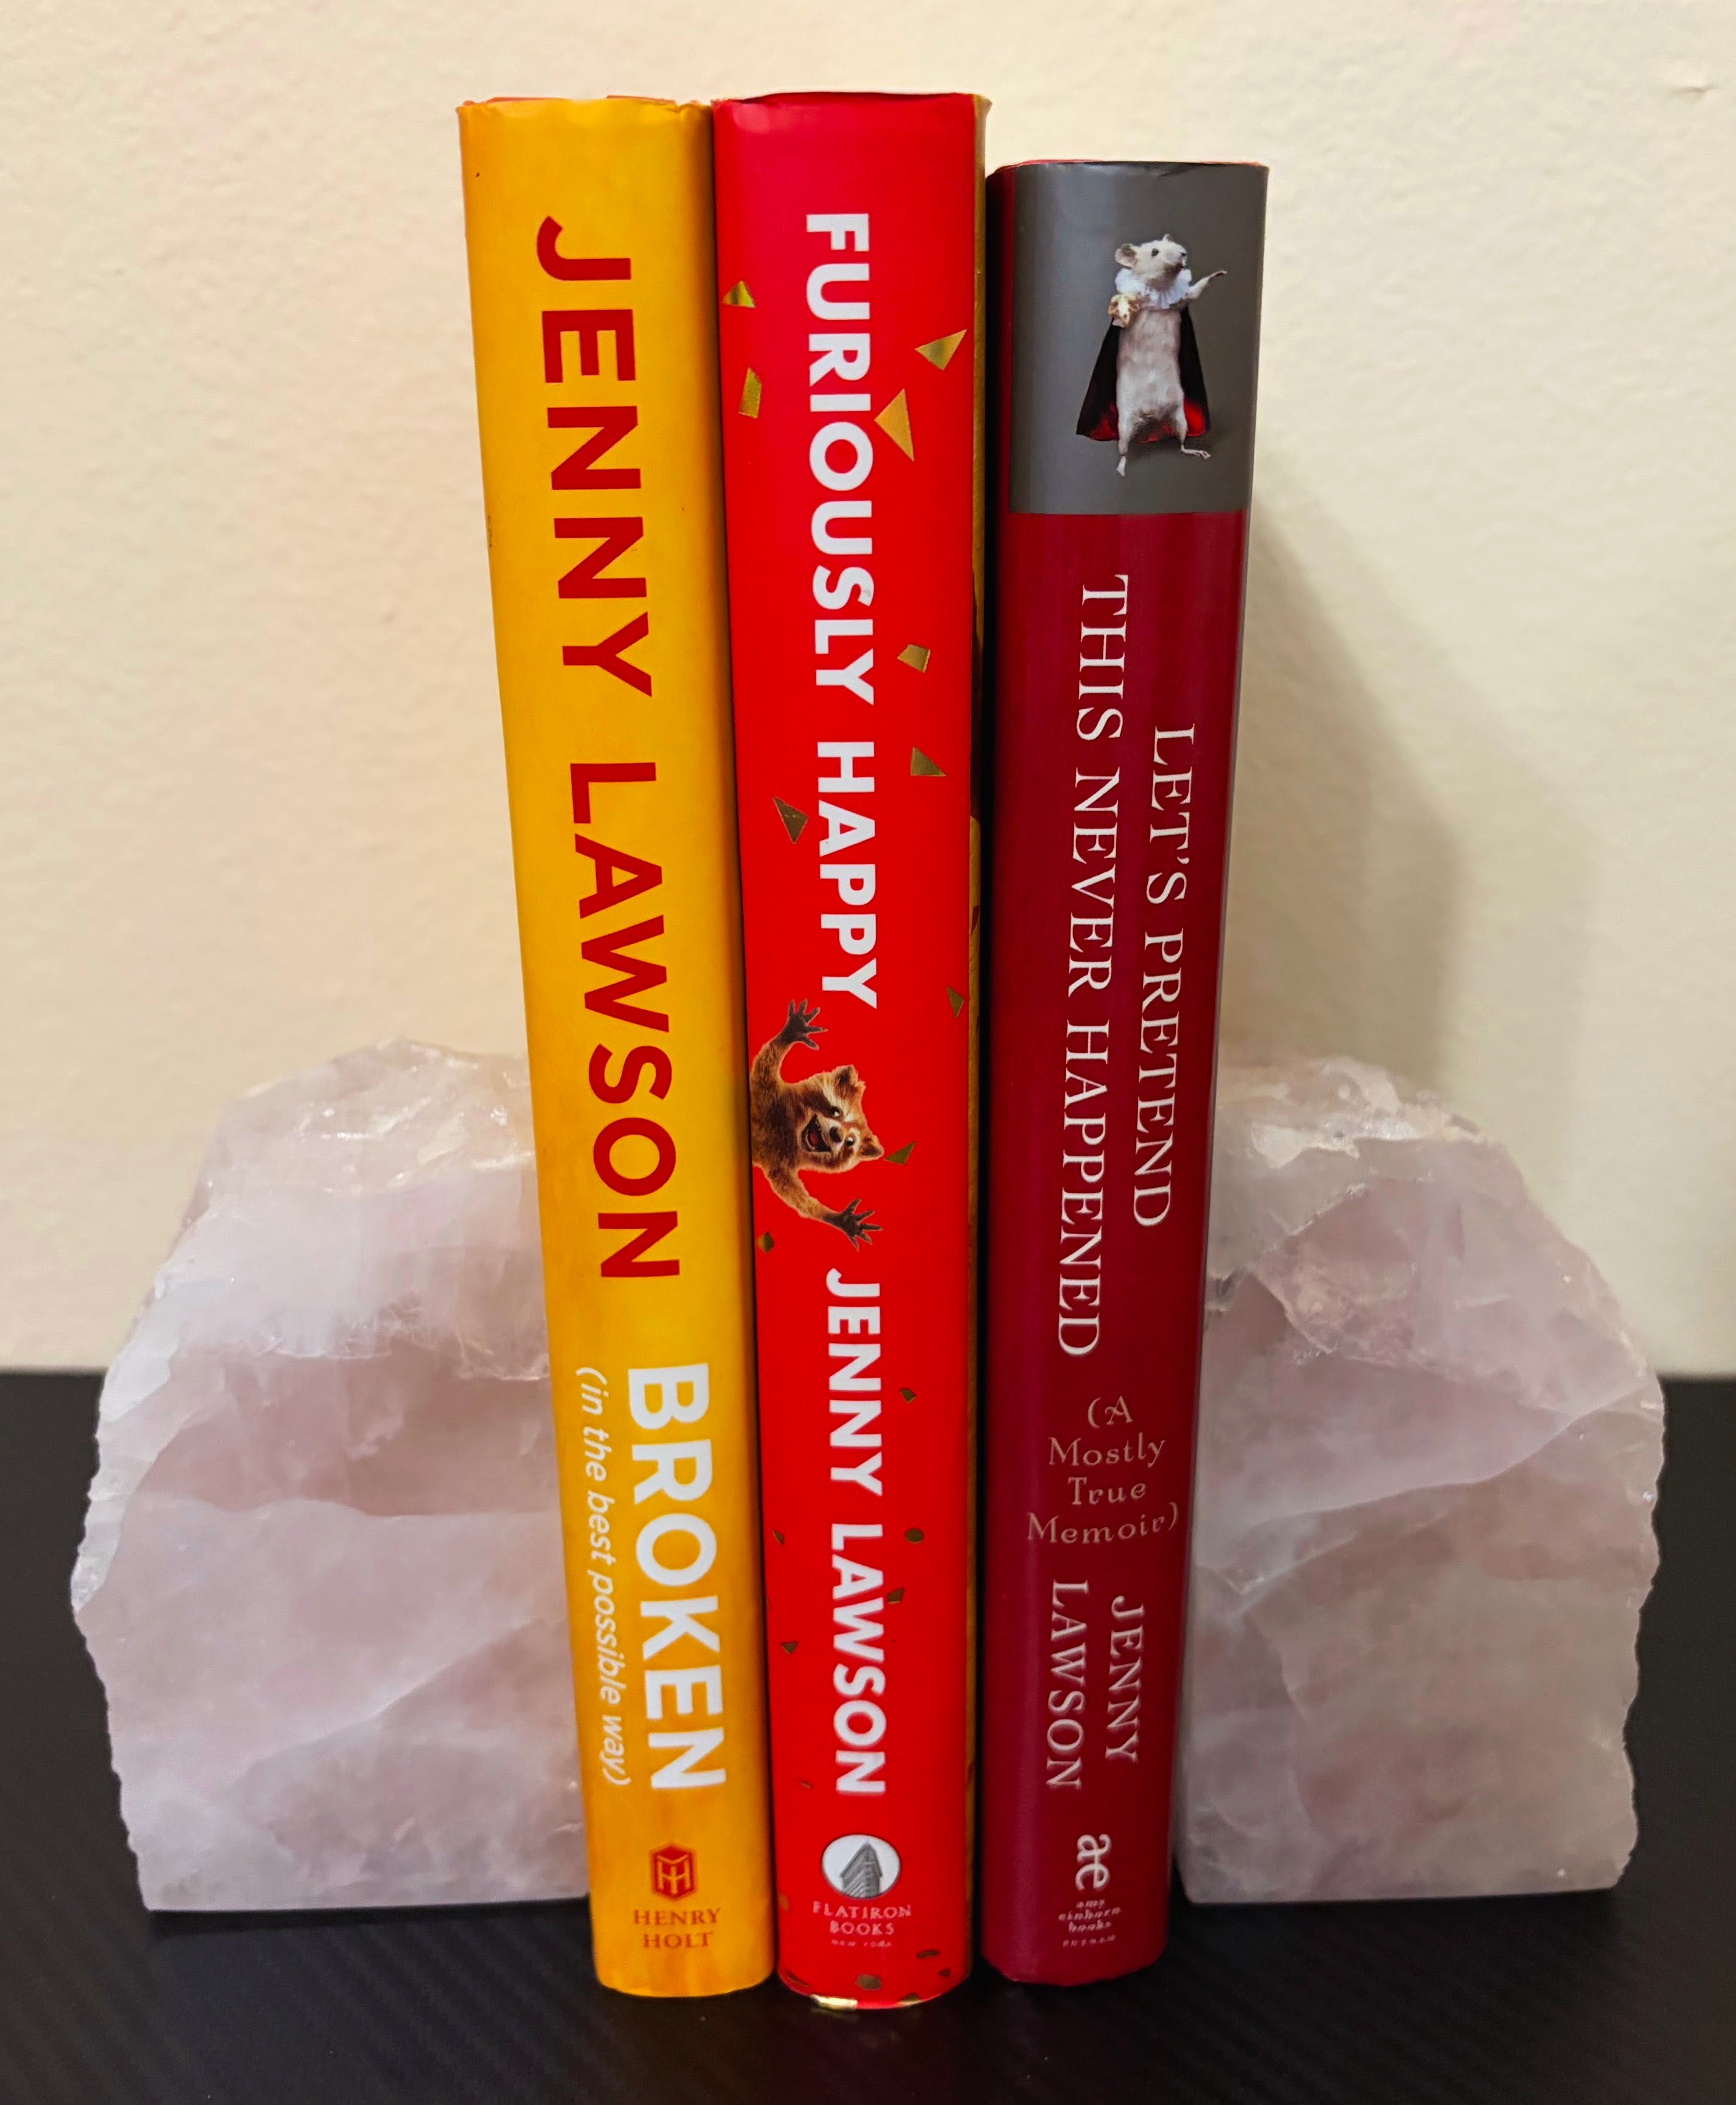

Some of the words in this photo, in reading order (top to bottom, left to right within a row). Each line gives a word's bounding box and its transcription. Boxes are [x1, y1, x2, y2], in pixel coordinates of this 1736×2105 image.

[536, 215, 652, 697] JENNY
[805, 213, 875, 706] FURIOUSLY
[1075, 574, 1128, 741] THIS
[817, 741, 877, 1010] HAPPY
[1068, 766, 1120, 998] NEVER
[1145, 723, 1195, 905] LET'S
[570, 761, 680, 1277] LAWSON
[1133, 926, 1184, 1229] PRETEND
[1058, 1019, 1110, 1358] HAPPENED
[575, 1367, 607, 1416] (in
[582, 1425, 608, 1482] the
[825, 1267, 883, 1497] JENNY
[1049, 1432, 1166, 1468] Mostly
[1087, 1395, 1133, 1428] (A
[587, 1490, 616, 1564] best
[1026, 1501, 1179, 1545] Memoir)
[1068, 1477, 1147, 1505] True
[587, 1567, 627, 1705] possible
[628, 1362, 726, 1790] BROKEN
[830, 1523, 887, 1796] LAWSON
[599, 1715, 631, 1787] way)
[1046, 1579, 1089, 1790] LAWSON
[1105, 1595, 1145, 1763] JENNY
[633, 1907, 721, 1926] HENRY
[642, 1931, 713, 1949] HOLT
[813, 1900, 912, 1919] FLATIRON
[830, 1919, 895, 1936] BOOKS
